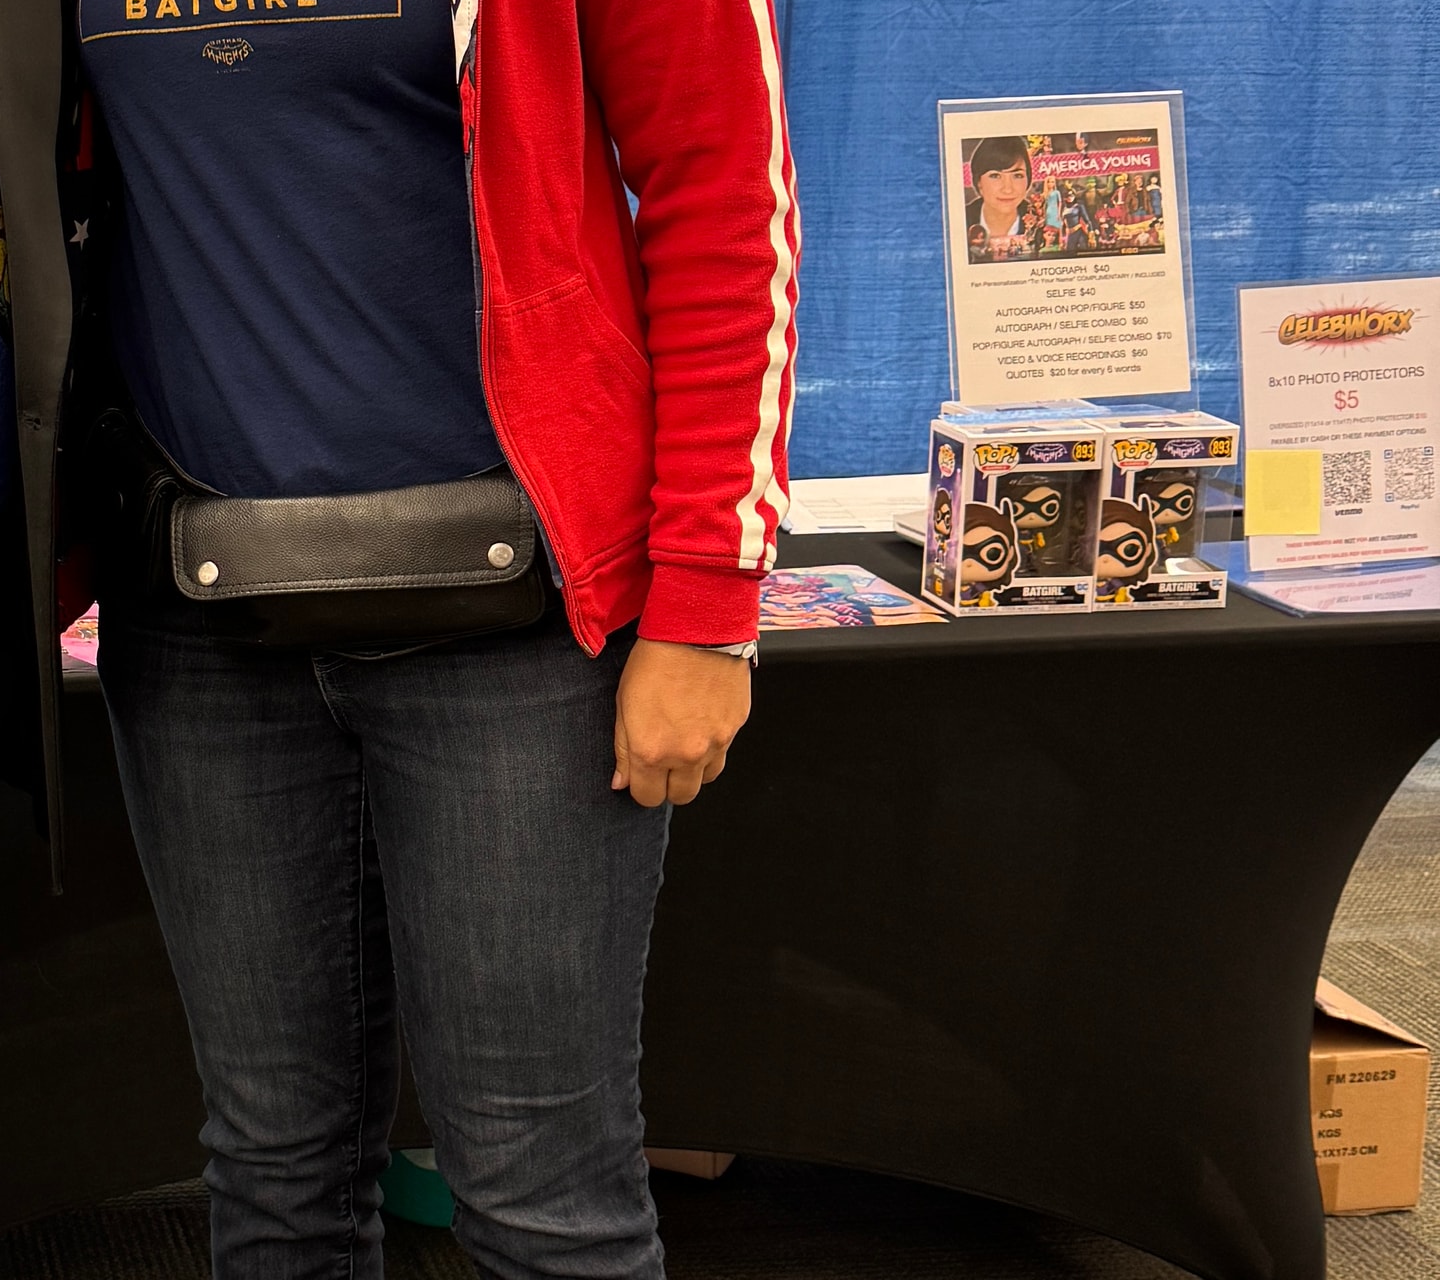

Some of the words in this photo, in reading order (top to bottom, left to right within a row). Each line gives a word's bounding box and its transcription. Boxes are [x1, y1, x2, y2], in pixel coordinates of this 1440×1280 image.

[207, 45, 249, 66] KNIGHTS
[1038, 159, 1100, 175] AMERICA
[1101, 153, 1152, 170] YOUNG
[1030, 266, 1087, 276] AUTOGRAPH
[1094, 264, 1110, 273] $40
[1046, 288, 1076, 298] SELFIE
[1080, 287, 1096, 297] $40
[996, 306, 1052, 317] AUTOGRAPH
[1054, 305, 1069, 314] ON
[1129, 301, 1145, 310] $50
[995, 322, 1051, 333] AUTOGRAPH
[1059, 320, 1089, 329] SELFIE
[1091, 317, 1127, 328] COMBO
[1132, 316, 1148, 326] $60
[1278, 307, 1415, 345] CELEBWORX
[1027, 336, 1081, 347] AUTOGRAPH
[1088, 334, 1117, 344] SELFIE
[1118, 332, 1152, 342] COMBO
[1156, 331, 1172, 340] $70
[997, 355, 1025, 365] VIDEO
[1027, 355, 1034, 363] &
[1036, 353, 1064, 363] VOICE
[1066, 349, 1126, 361] RECORDINGS
[1131, 348, 1148, 357] $60
[1006, 369, 1044, 379] QUOTES
[1050, 368, 1066, 377] $20
[1067, 367, 1079, 376] for
[1081, 366, 1105, 375] every
[1114, 364, 1142, 373] words
[1268, 375, 1295, 388] 8x10
[1298, 372, 1340, 385] PHOTO
[1343, 366, 1425, 382] PROTECTORS
[1334, 389, 1360, 411] $5
[974, 444, 1018, 465] POP!
[1075, 445, 1093, 459] 893
[1113, 440, 1156, 461] POP!
[1212, 441, 1231, 454] 893
[1022, 586, 1064, 597] BATGIRL
[1158, 582, 1199, 592] BATGIRL
[1326, 1074, 1346, 1085] FM
[1317, 1128, 1341, 1138] KGS
[1359, 1145, 1378, 1155] CM
